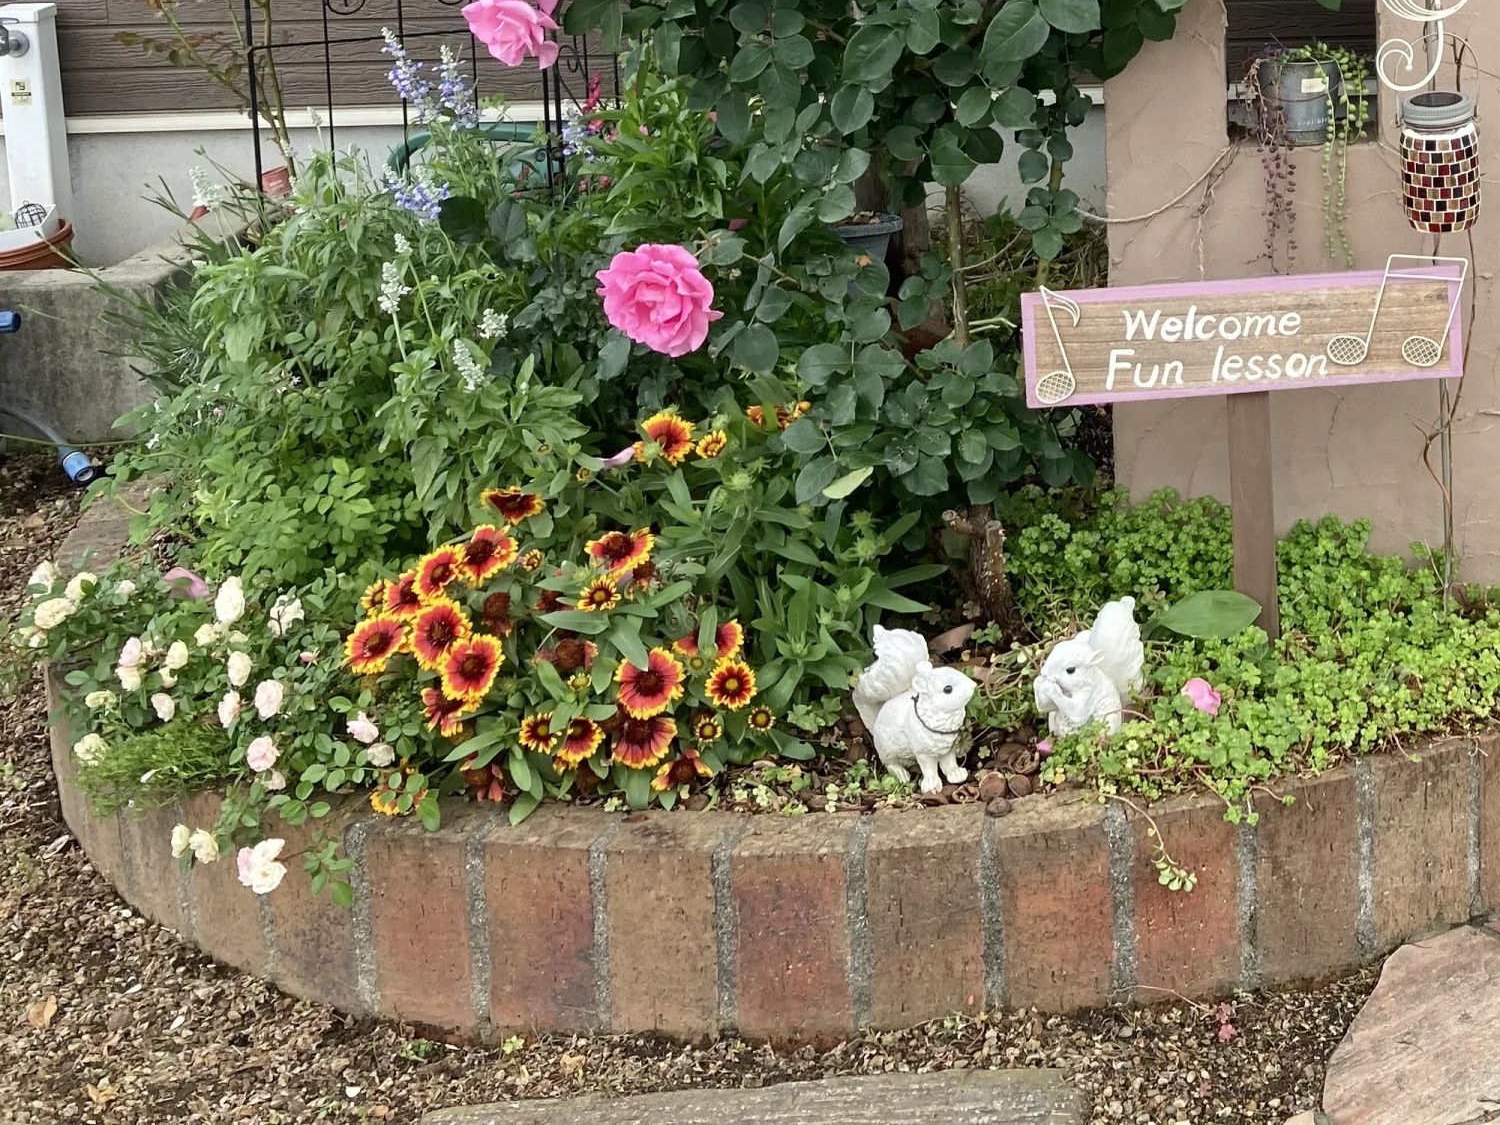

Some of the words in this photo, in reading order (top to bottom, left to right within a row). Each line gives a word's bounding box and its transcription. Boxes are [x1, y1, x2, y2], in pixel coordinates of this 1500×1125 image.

[1121, 304, 1302, 343] Welcome
[1105, 348, 1184, 391] Fun
[1211, 345, 1328, 384] lesson
